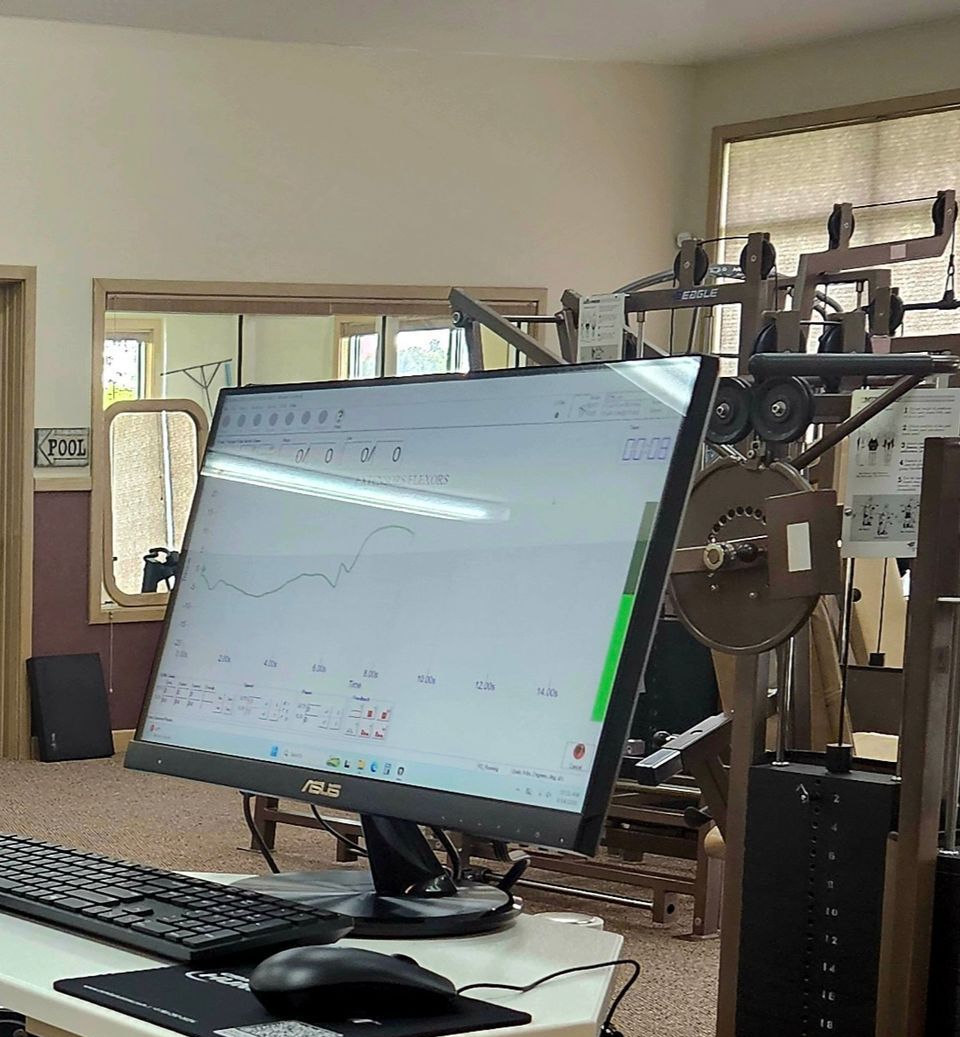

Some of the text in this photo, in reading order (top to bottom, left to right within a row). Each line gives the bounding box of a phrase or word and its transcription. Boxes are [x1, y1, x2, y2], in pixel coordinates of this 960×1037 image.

[681, 288, 719, 300] EAGLE
[47, 438, 87, 457] POOL
[475, 680, 496, 691] 12.00s
[537, 687, 559, 698] 14.00s
[301, 779, 342, 798] ASUS
[833, 794, 840, 803] 2
[828, 851, 836, 860] 6
[825, 907, 838, 917] 10
[825, 934, 838, 946] 12
[823, 962, 836, 973] 14
[820, 1018, 833, 1029] 18
